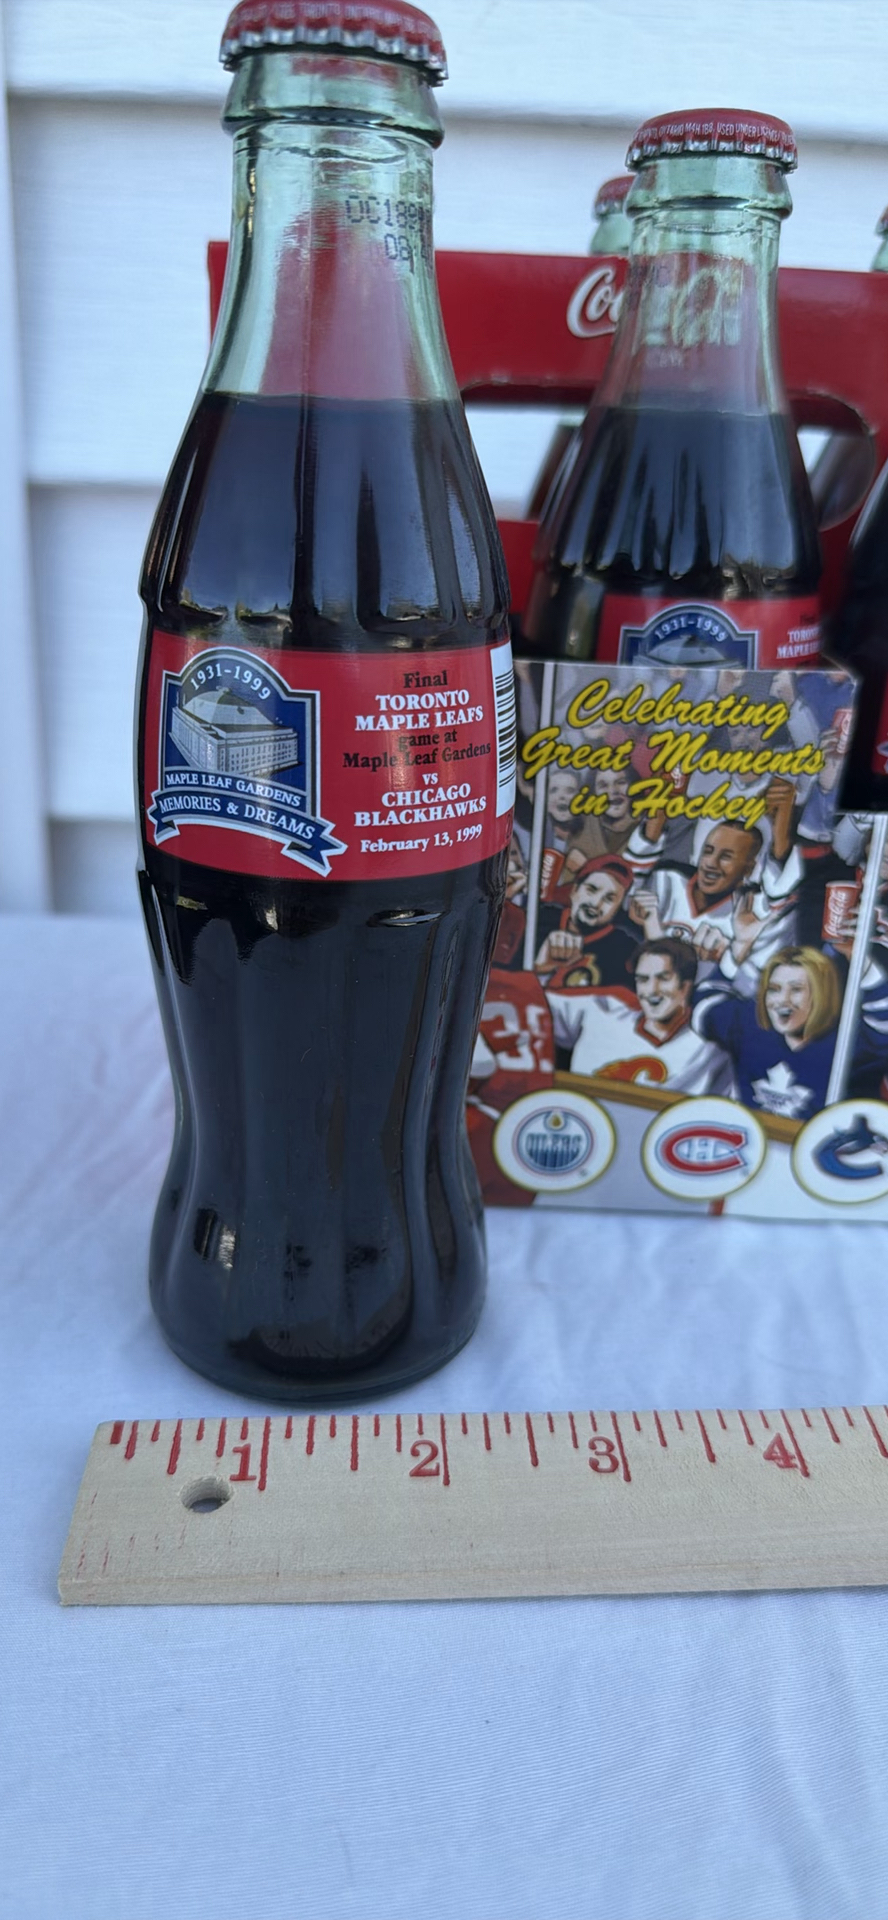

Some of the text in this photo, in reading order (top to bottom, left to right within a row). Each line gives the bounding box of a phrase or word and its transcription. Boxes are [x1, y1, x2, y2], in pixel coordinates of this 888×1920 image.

[717, 122, 734, 136] USED
[736, 122, 757, 137] UNDER
[654, 615, 727, 643] 1931-1999
[190, 663, 271, 700] 1931-1999
[403, 670, 448, 688] Final
[375, 689, 470, 711] TORONTO
[567, 679, 790, 741] Celebrating
[354, 705, 484, 731] MAPLE LEAFS
[398, 730, 458, 750] game at
[521, 726, 634, 780] Great
[648, 731, 826, 777] Moments
[342, 742, 491, 772] Maple Leaf Gardens
[165, 773, 302, 807] MAPLE LEAF GARDENS
[381, 783, 471, 807] CHICAGO
[569, 777, 768, 831] in Hockey
[159, 796, 315, 840] MEMORIES & DREAMS
[354, 796, 487, 827] BLACKHAWKS
[360, 824, 483, 853] February 13, 1999
[230, 1432, 798, 1481] 1 2 3 4
